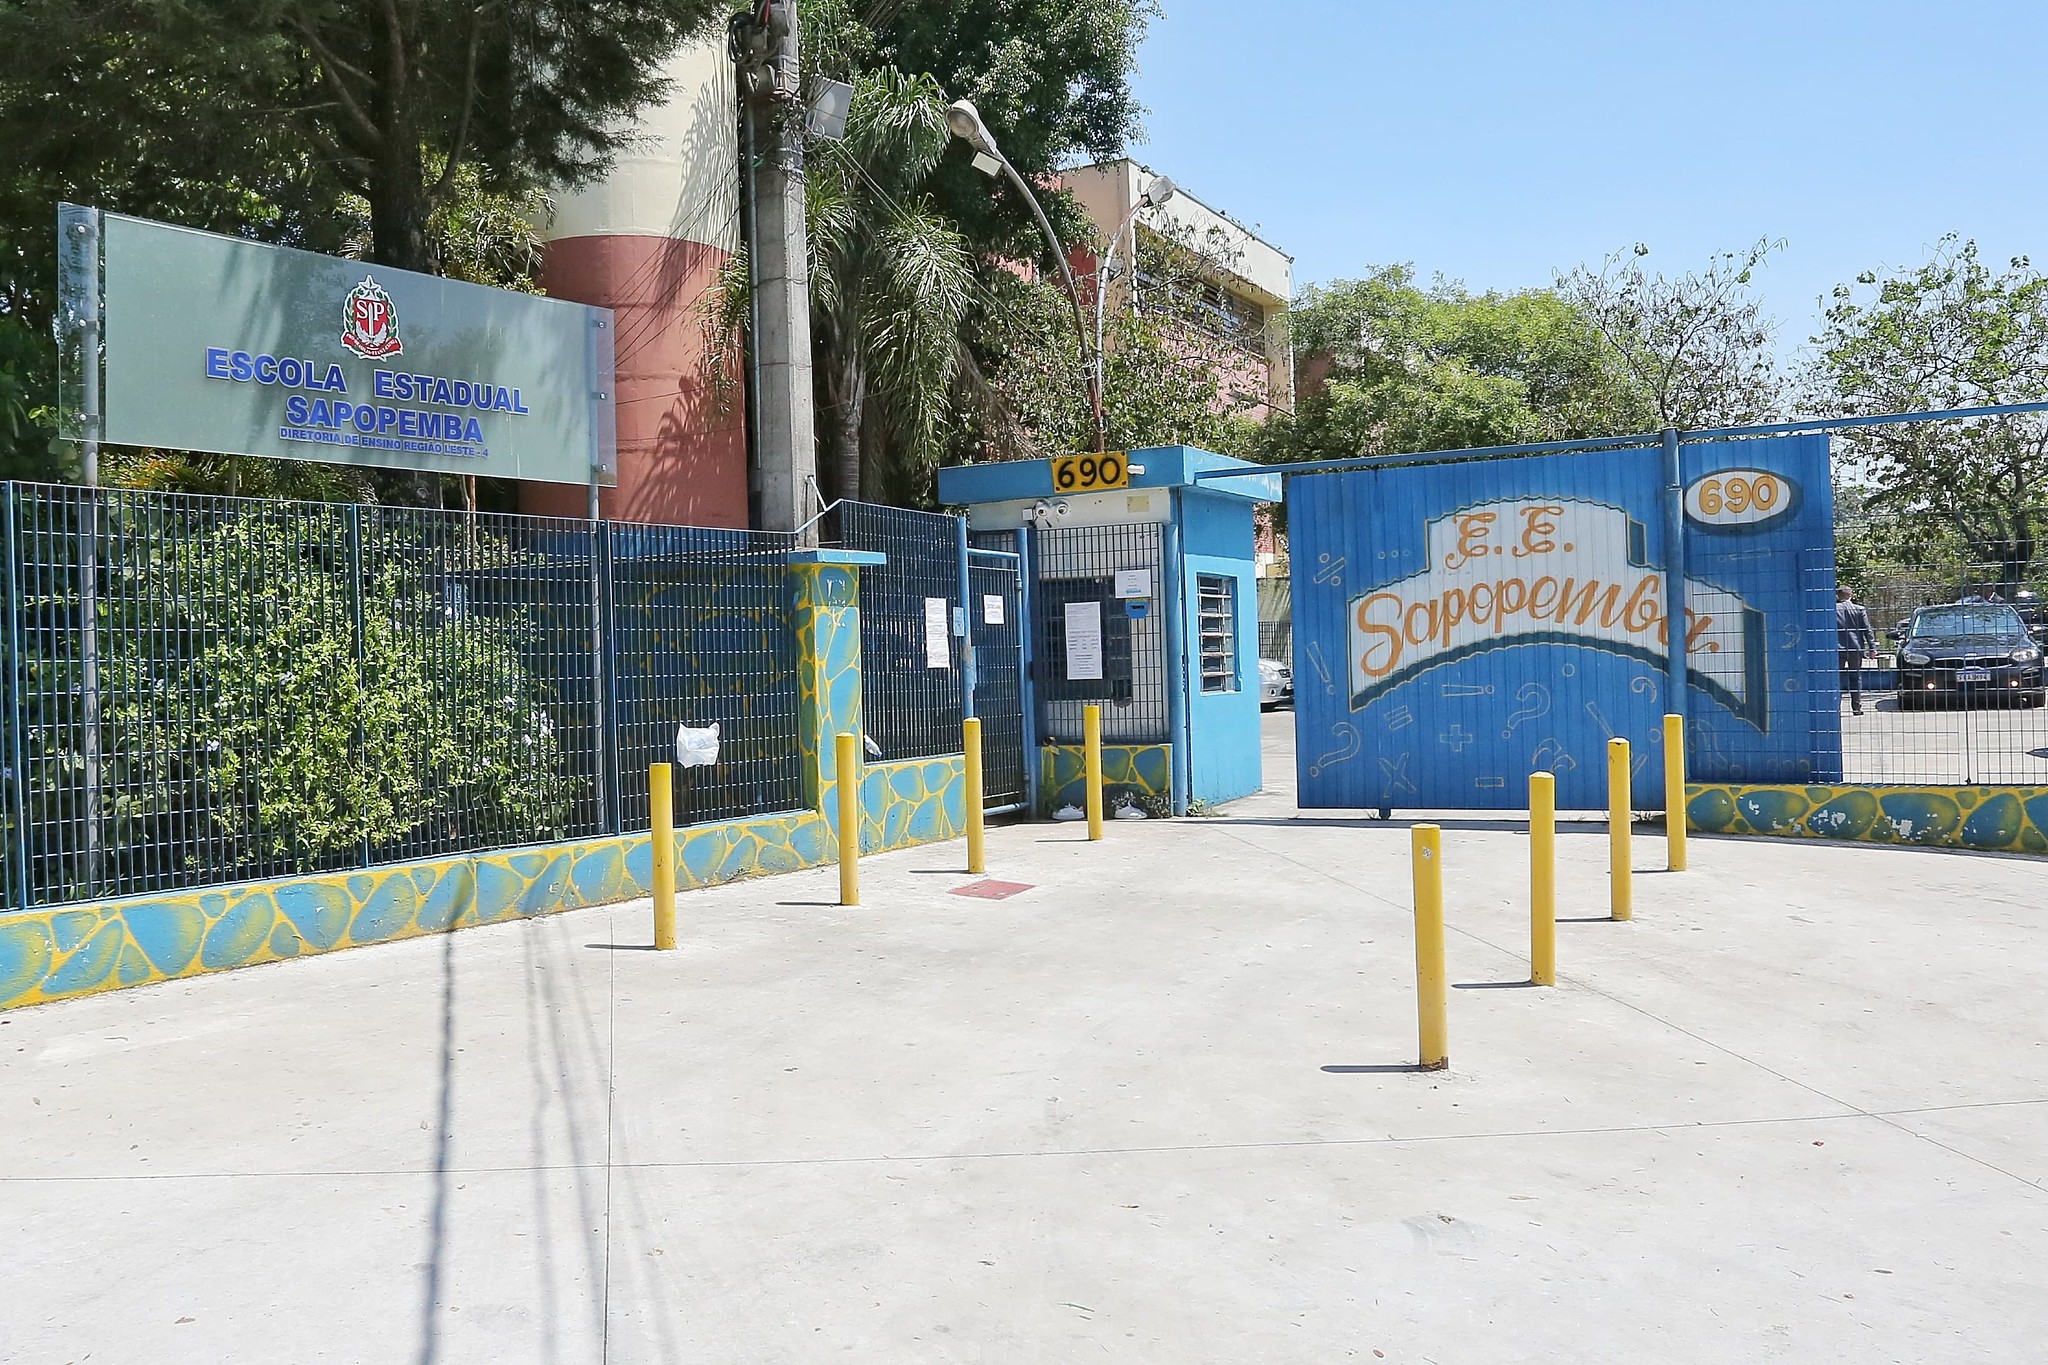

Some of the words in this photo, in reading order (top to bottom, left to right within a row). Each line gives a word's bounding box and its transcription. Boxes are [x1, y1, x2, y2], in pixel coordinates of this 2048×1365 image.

[356, 300, 385, 321] SP
[206, 347, 348, 394] ESCOLA
[374, 369, 529, 415] ESTADUAL
[286, 395, 484, 444] SAPOPEMBA
[279, 426, 341, 445] DIRETORIA
[343, 433, 360, 447] DE
[361, 435, 403, 450] ENSINO
[403, 440, 443, 455] REGIÃO
[444, 443, 476, 457] LESTE
[483, 448, 490, 458] 4
[1058, 458, 1120, 488] 690
[1699, 474, 1779, 515] 690
